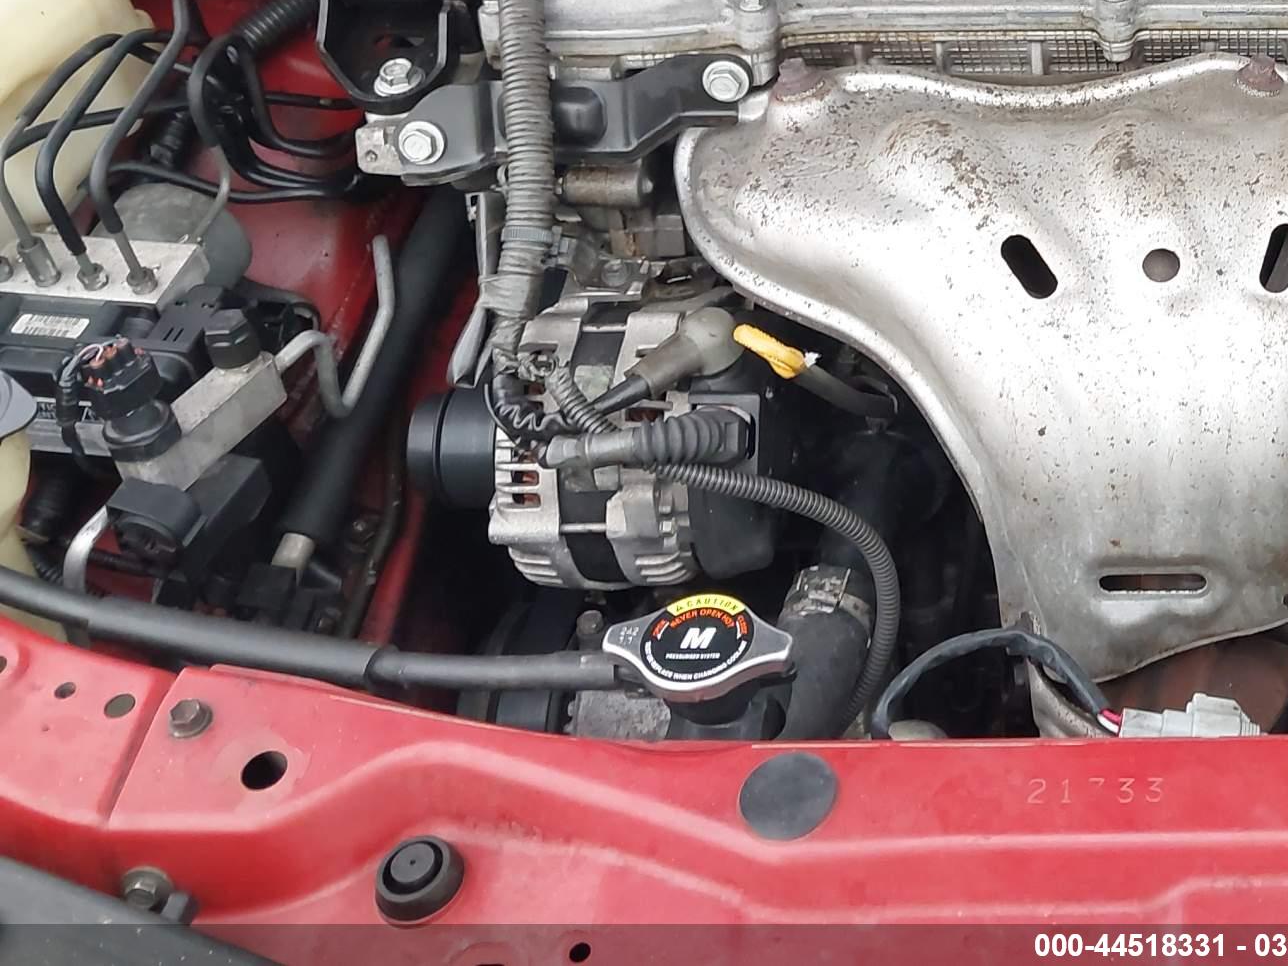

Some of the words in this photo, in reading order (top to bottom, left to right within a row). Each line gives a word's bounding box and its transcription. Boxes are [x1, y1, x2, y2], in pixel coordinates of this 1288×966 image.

[687, 598, 739, 611] CAUTION
[669, 610, 698, 628] NEVER
[700, 609, 724, 620] OPEN
[680, 627, 717, 649] M
